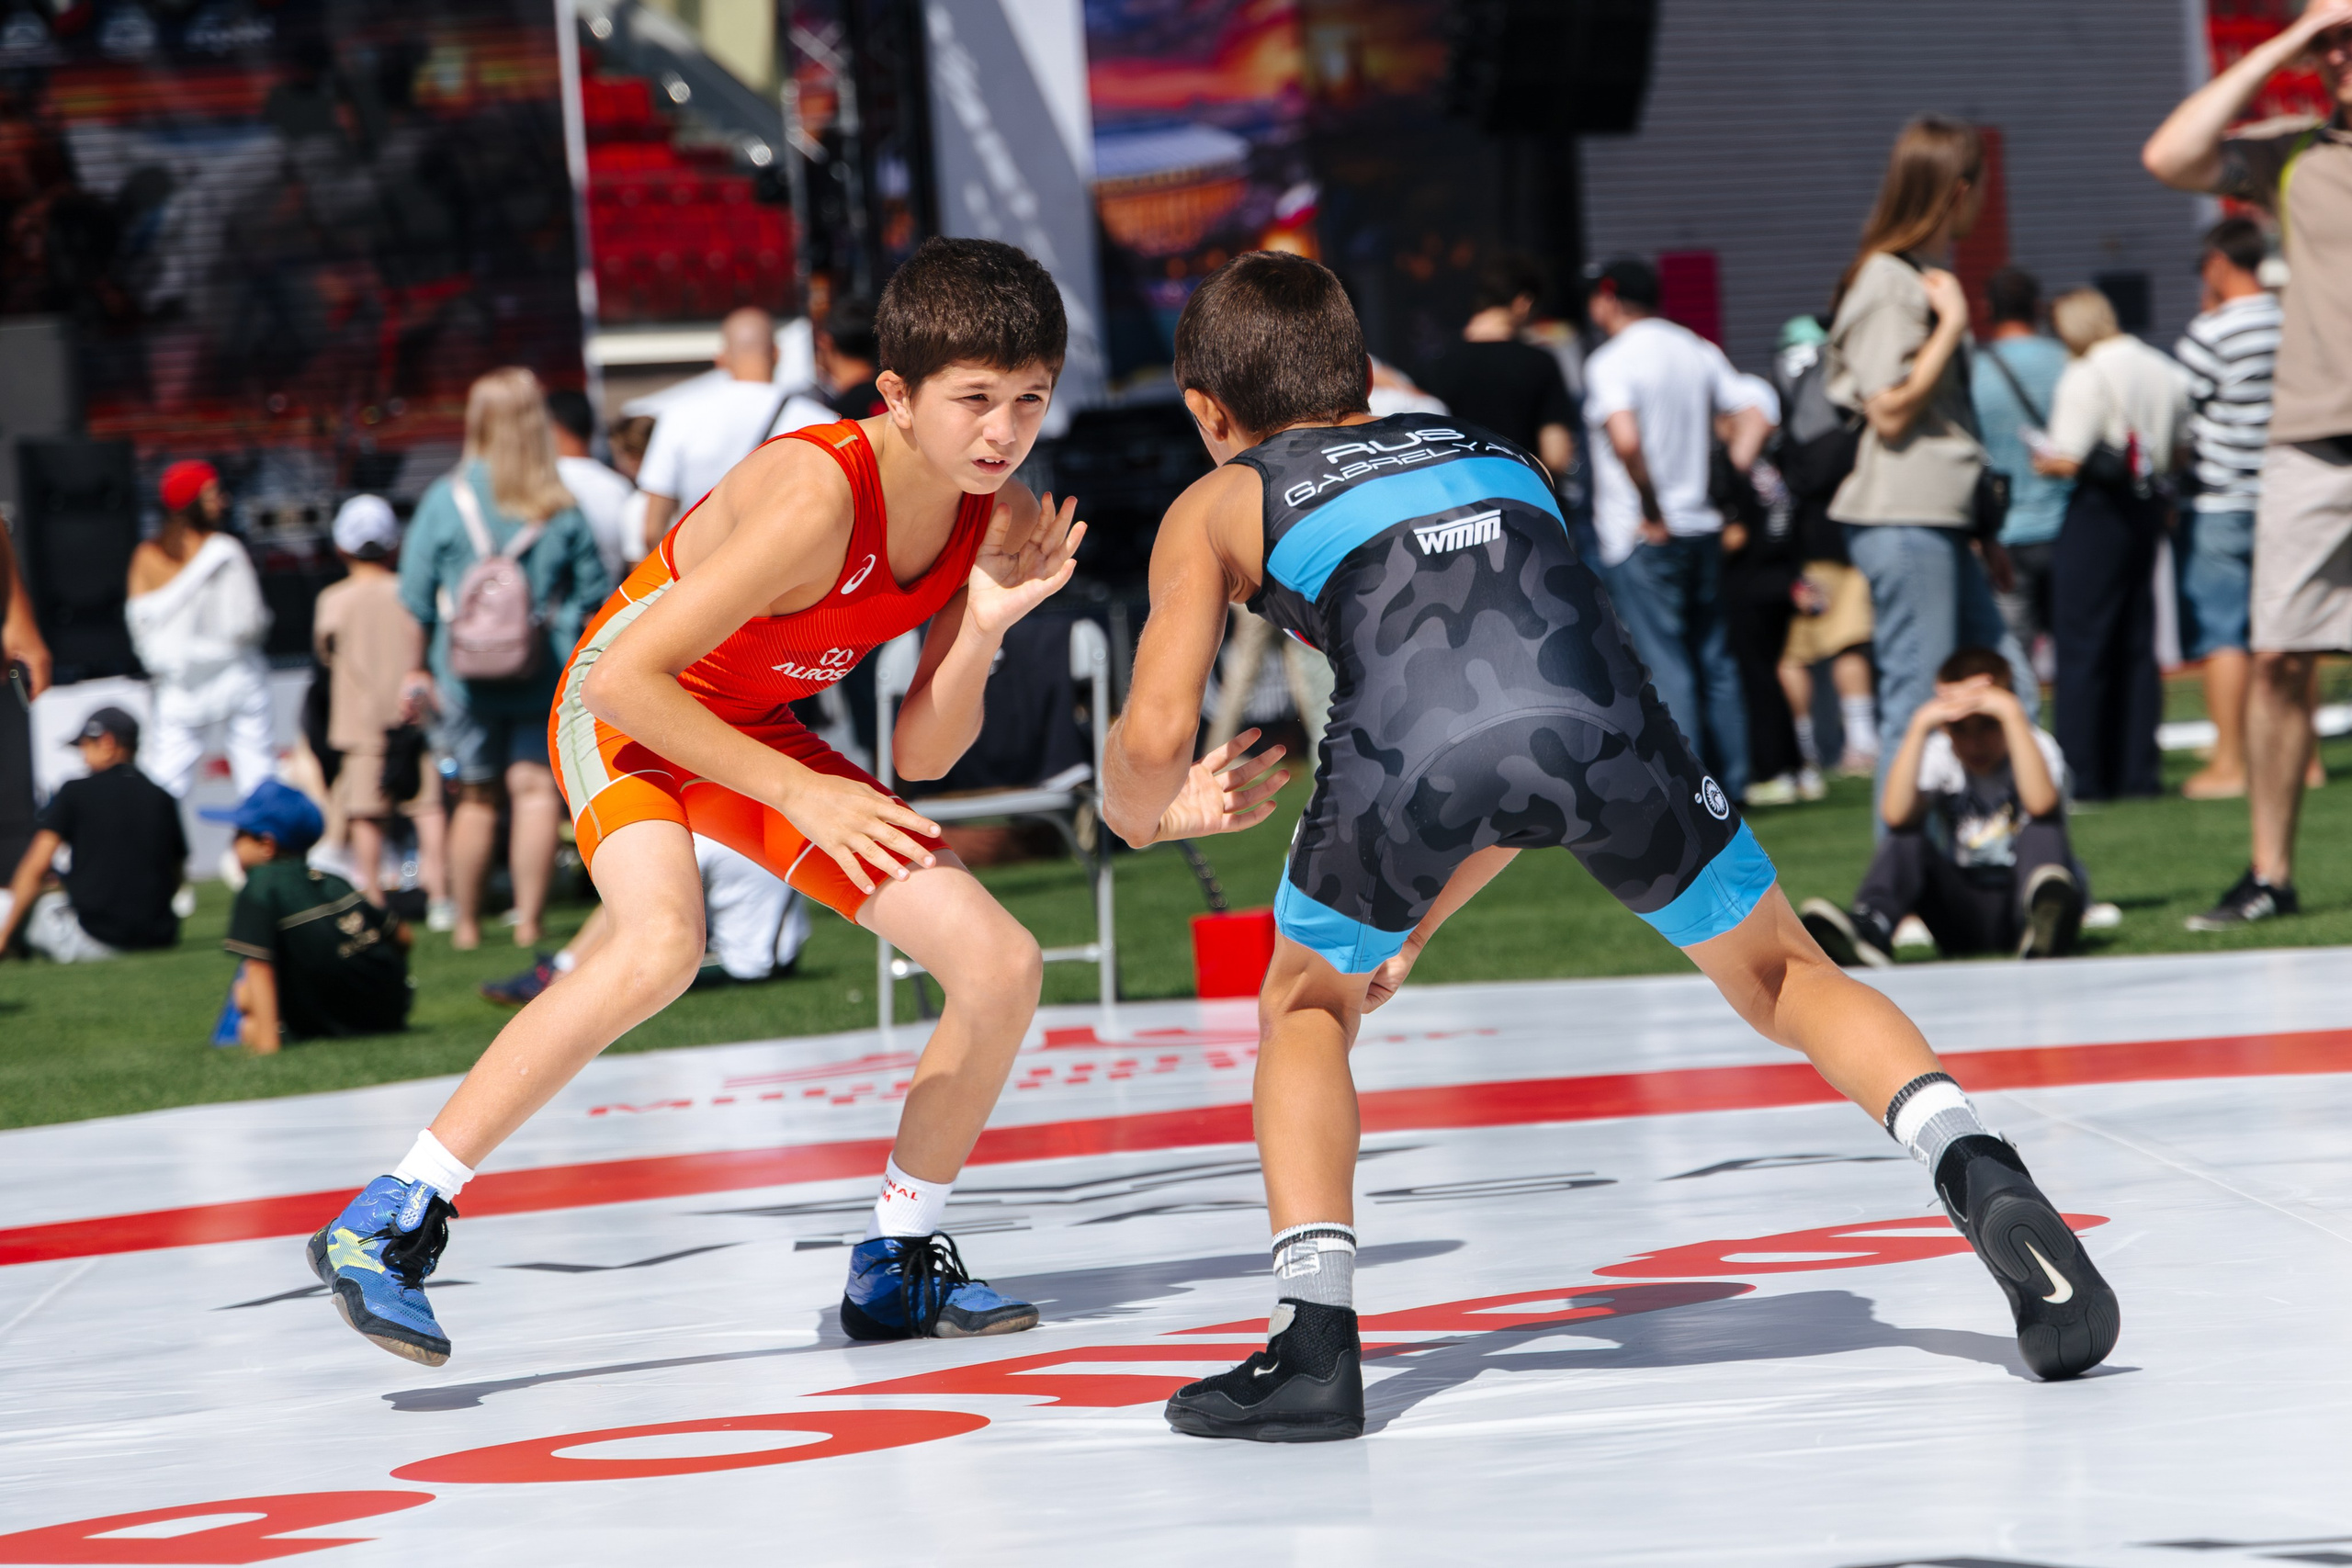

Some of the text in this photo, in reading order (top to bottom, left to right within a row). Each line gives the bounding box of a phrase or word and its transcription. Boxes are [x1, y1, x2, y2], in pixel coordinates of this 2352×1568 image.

[1321, 428, 1465, 464] RUS
[1284, 441, 1531, 507] GABRELYAN
[771, 661, 849, 682] ALROS
